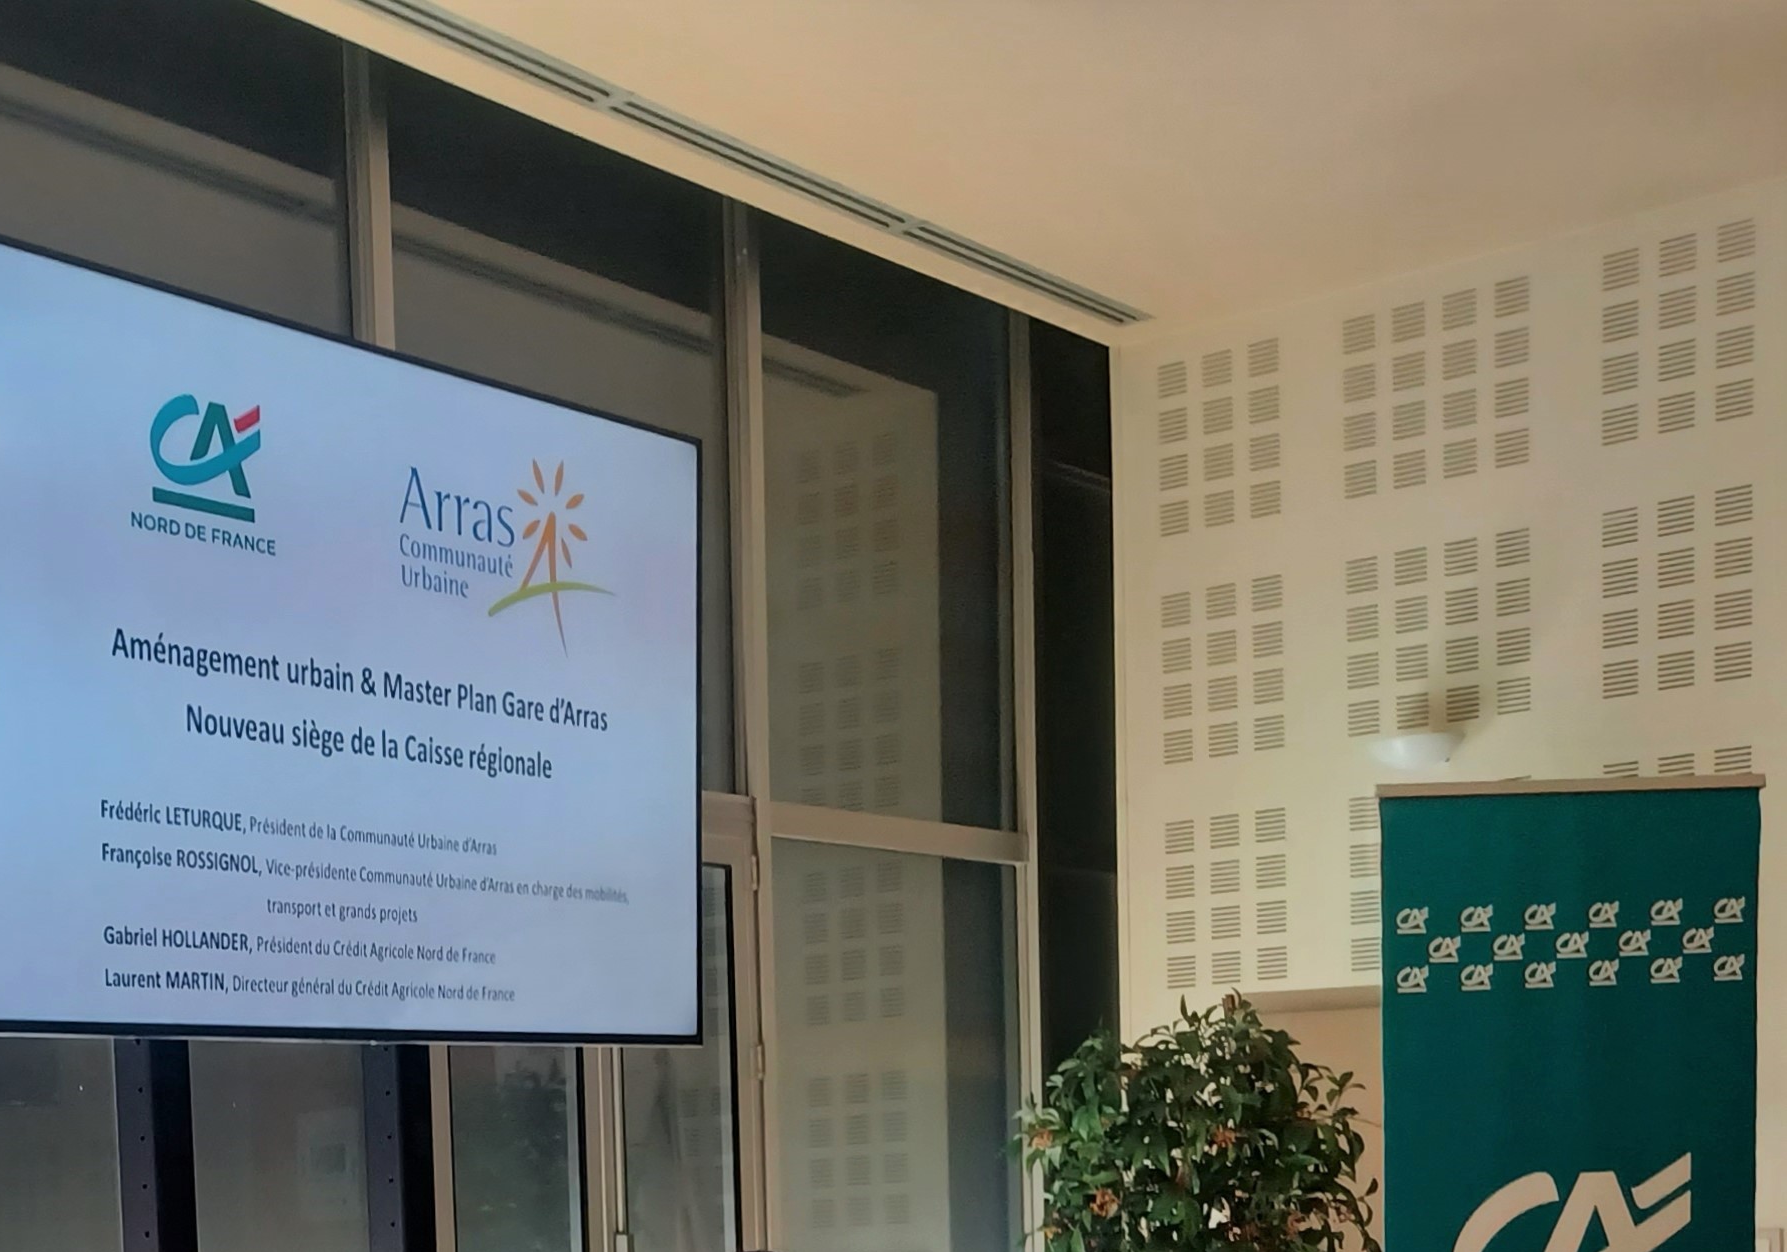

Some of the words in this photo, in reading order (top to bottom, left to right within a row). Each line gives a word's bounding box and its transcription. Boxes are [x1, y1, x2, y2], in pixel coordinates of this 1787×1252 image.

[400, 466, 514, 548] Arras
[130, 511, 181, 536] NORD
[184, 522, 207, 543] DE
[211, 527, 276, 557] FRANCE
[400, 533, 513, 578] Communauté
[402, 564, 469, 599] Urbaine
[111, 627, 280, 682] Aménagement
[287, 657, 354, 693] urbain
[360, 667, 377, 697] &
[383, 671, 452, 707] Master
[457, 683, 497, 715] Plan
[502, 691, 545, 722] Gare
[549, 697, 608, 732] d'Arras
[186, 703, 285, 745] Nouveau
[291, 719, 345, 758] siège
[350, 726, 376, 757] de
[381, 729, 399, 760] la
[404, 735, 464, 768] Caisse
[469, 743, 553, 779] régionale
[100, 799, 161, 825] Frédéric
[165, 805, 247, 835] LETURQUE,
[249, 815, 306, 838] Président
[308, 822, 324, 839] de
[326, 823, 337, 841] la
[340, 825, 415, 848] Communauté
[417, 833, 460, 852] Urbaine
[462, 837, 497, 856] d'Arras
[101, 842, 173, 870] Françoise
[176, 849, 262, 877] ROSSIGNOL,
[265, 859, 357, 882] Vice-présidente
[359, 866, 433, 888] Communauté
[435, 873, 478, 891] Urbaine
[479, 877, 515, 894] d'Arras
[516, 882, 529, 895] en
[531, 880, 564, 901] charge
[566, 883, 583, 900] des
[266, 898, 322, 919] transport
[324, 903, 336, 918] et
[339, 903, 377, 922] grands
[379, 908, 418, 925] projets
[103, 925, 158, 947] Gabriel
[162, 928, 253, 955] HOLLANDER,
[256, 935, 313, 955] Président
[314, 939, 330, 956] du
[333, 940, 368, 958] Crédit
[369, 942, 414, 962] Agricole
[416, 945, 444, 962] Nord
[445, 946, 460, 963] de
[462, 947, 496, 965] France
[105, 968, 162, 989] Laurent
[165, 970, 229, 994] MARTIN,
[232, 974, 289, 994] Directeur
[291, 977, 335, 998] général
[337, 979, 353, 996] du
[355, 980, 389, 997] Crédit
[391, 981, 435, 1001] Agricole
[437, 984, 464, 1000] Nord
[466, 985, 479, 1000] de
[481, 985, 515, 1002] France
